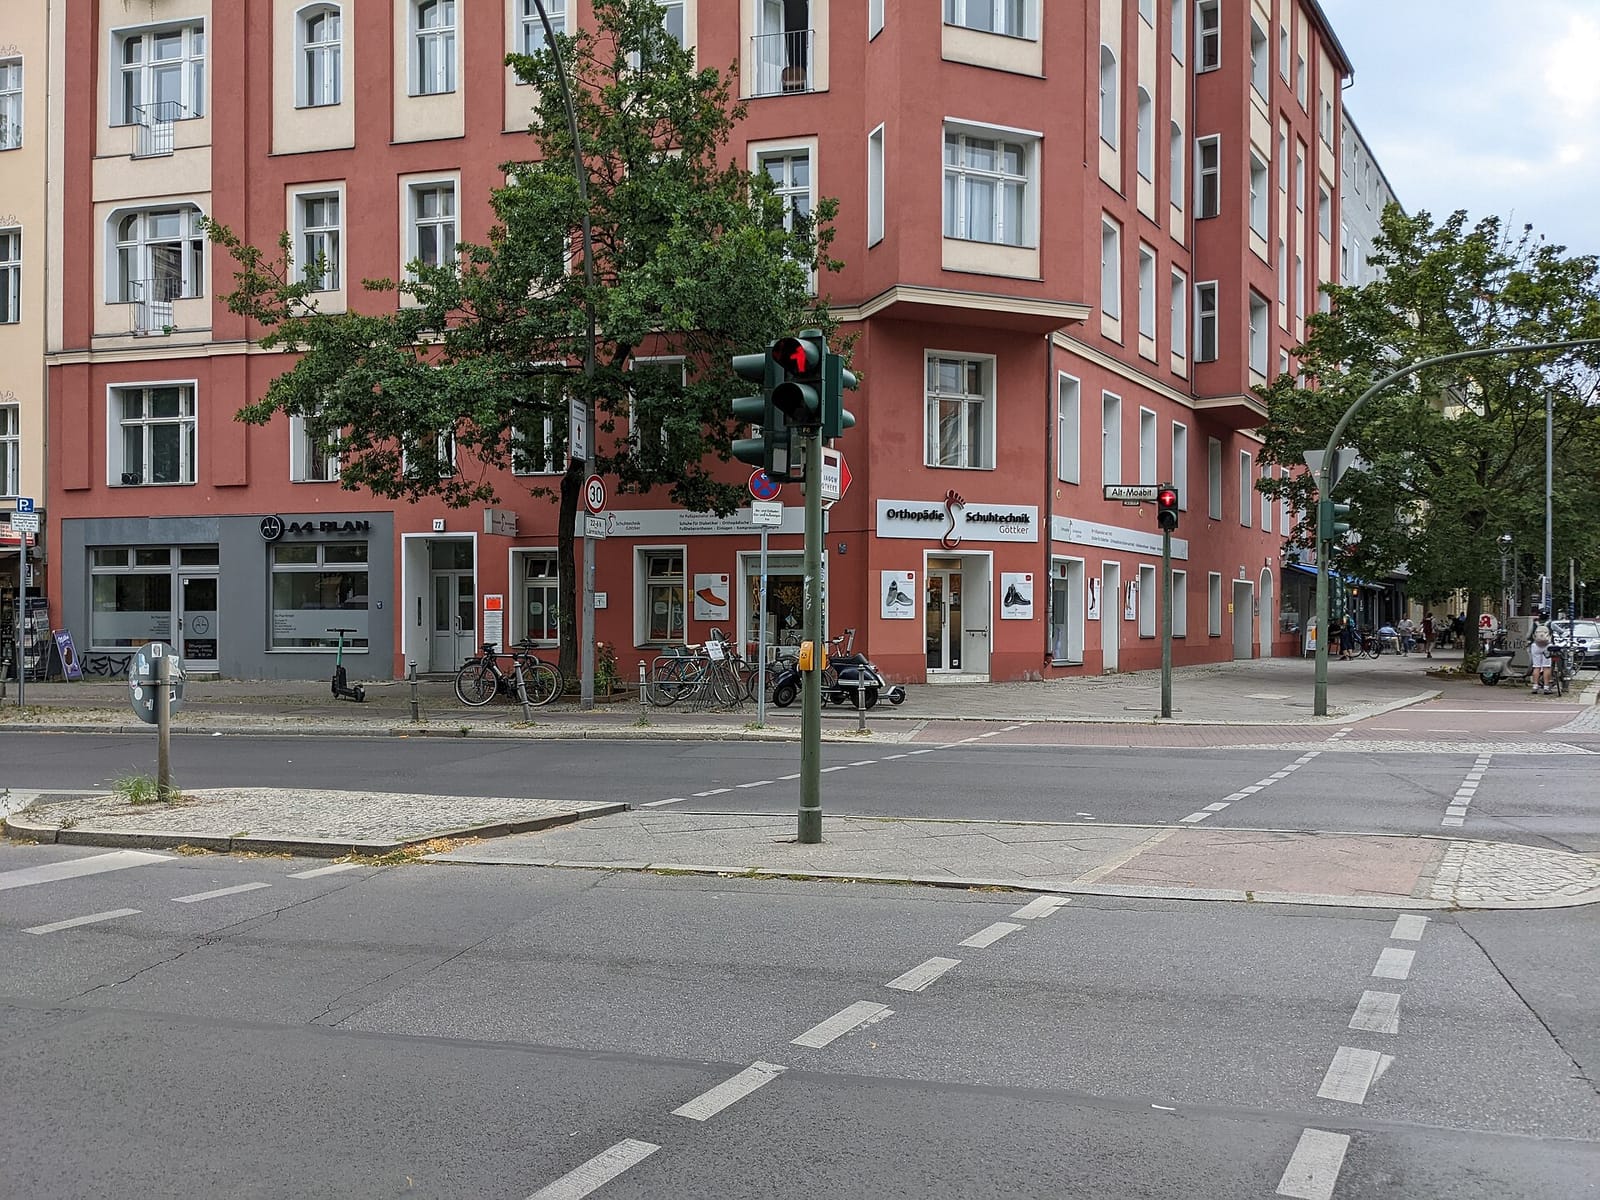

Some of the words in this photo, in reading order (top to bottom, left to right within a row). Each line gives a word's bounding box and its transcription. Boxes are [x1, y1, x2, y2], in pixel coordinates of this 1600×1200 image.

[590, 486, 602, 503] 30
[1111, 488, 1152, 497] Alt-Moabit
[20, 499, 29, 511] P
[886, 508, 945, 521] Orthopädie
[965, 511, 1030, 524] Schuhtechnik
[320, 521, 369, 531] PLAN
[999, 525, 1029, 534] Göttker
